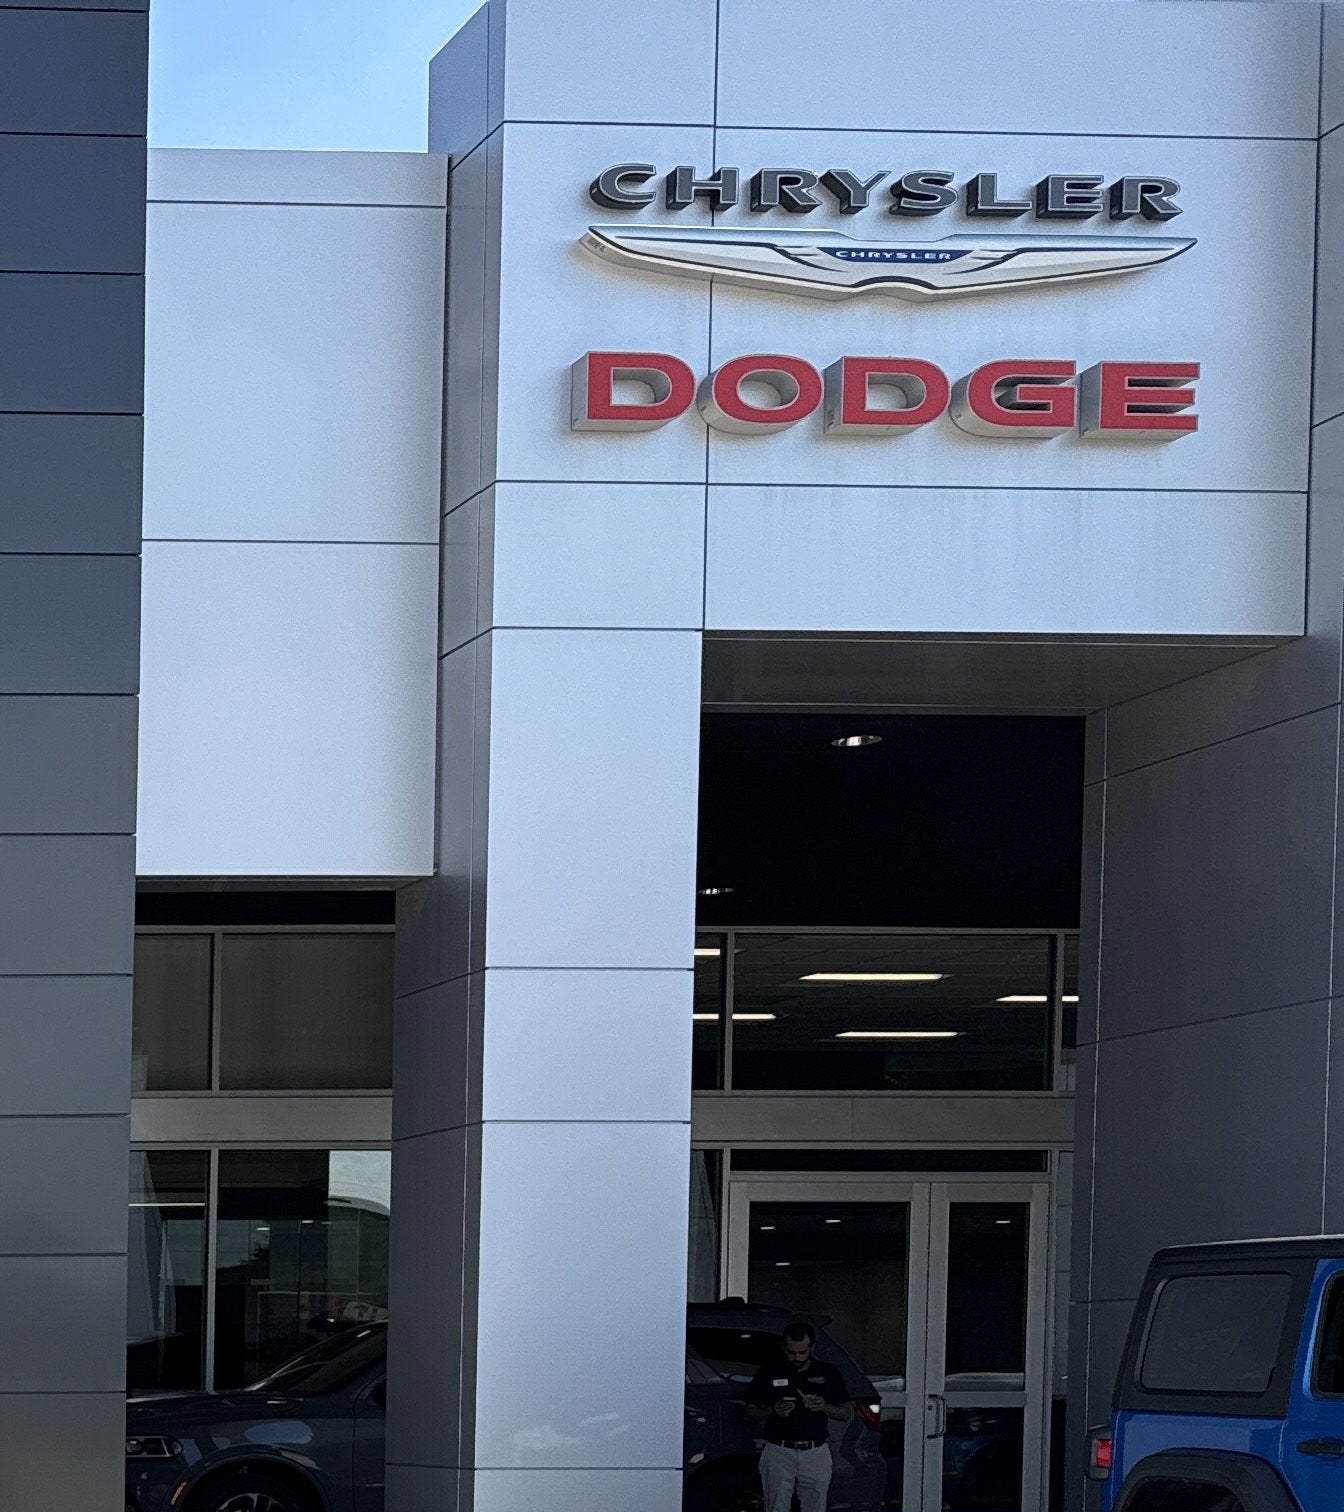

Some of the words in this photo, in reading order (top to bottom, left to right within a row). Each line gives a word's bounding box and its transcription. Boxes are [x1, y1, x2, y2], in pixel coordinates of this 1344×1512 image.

[589, 163, 1183, 222] CHRYSLER
[835, 250, 952, 260] CHRYSLER
[572, 351, 1200, 438] DODGE
